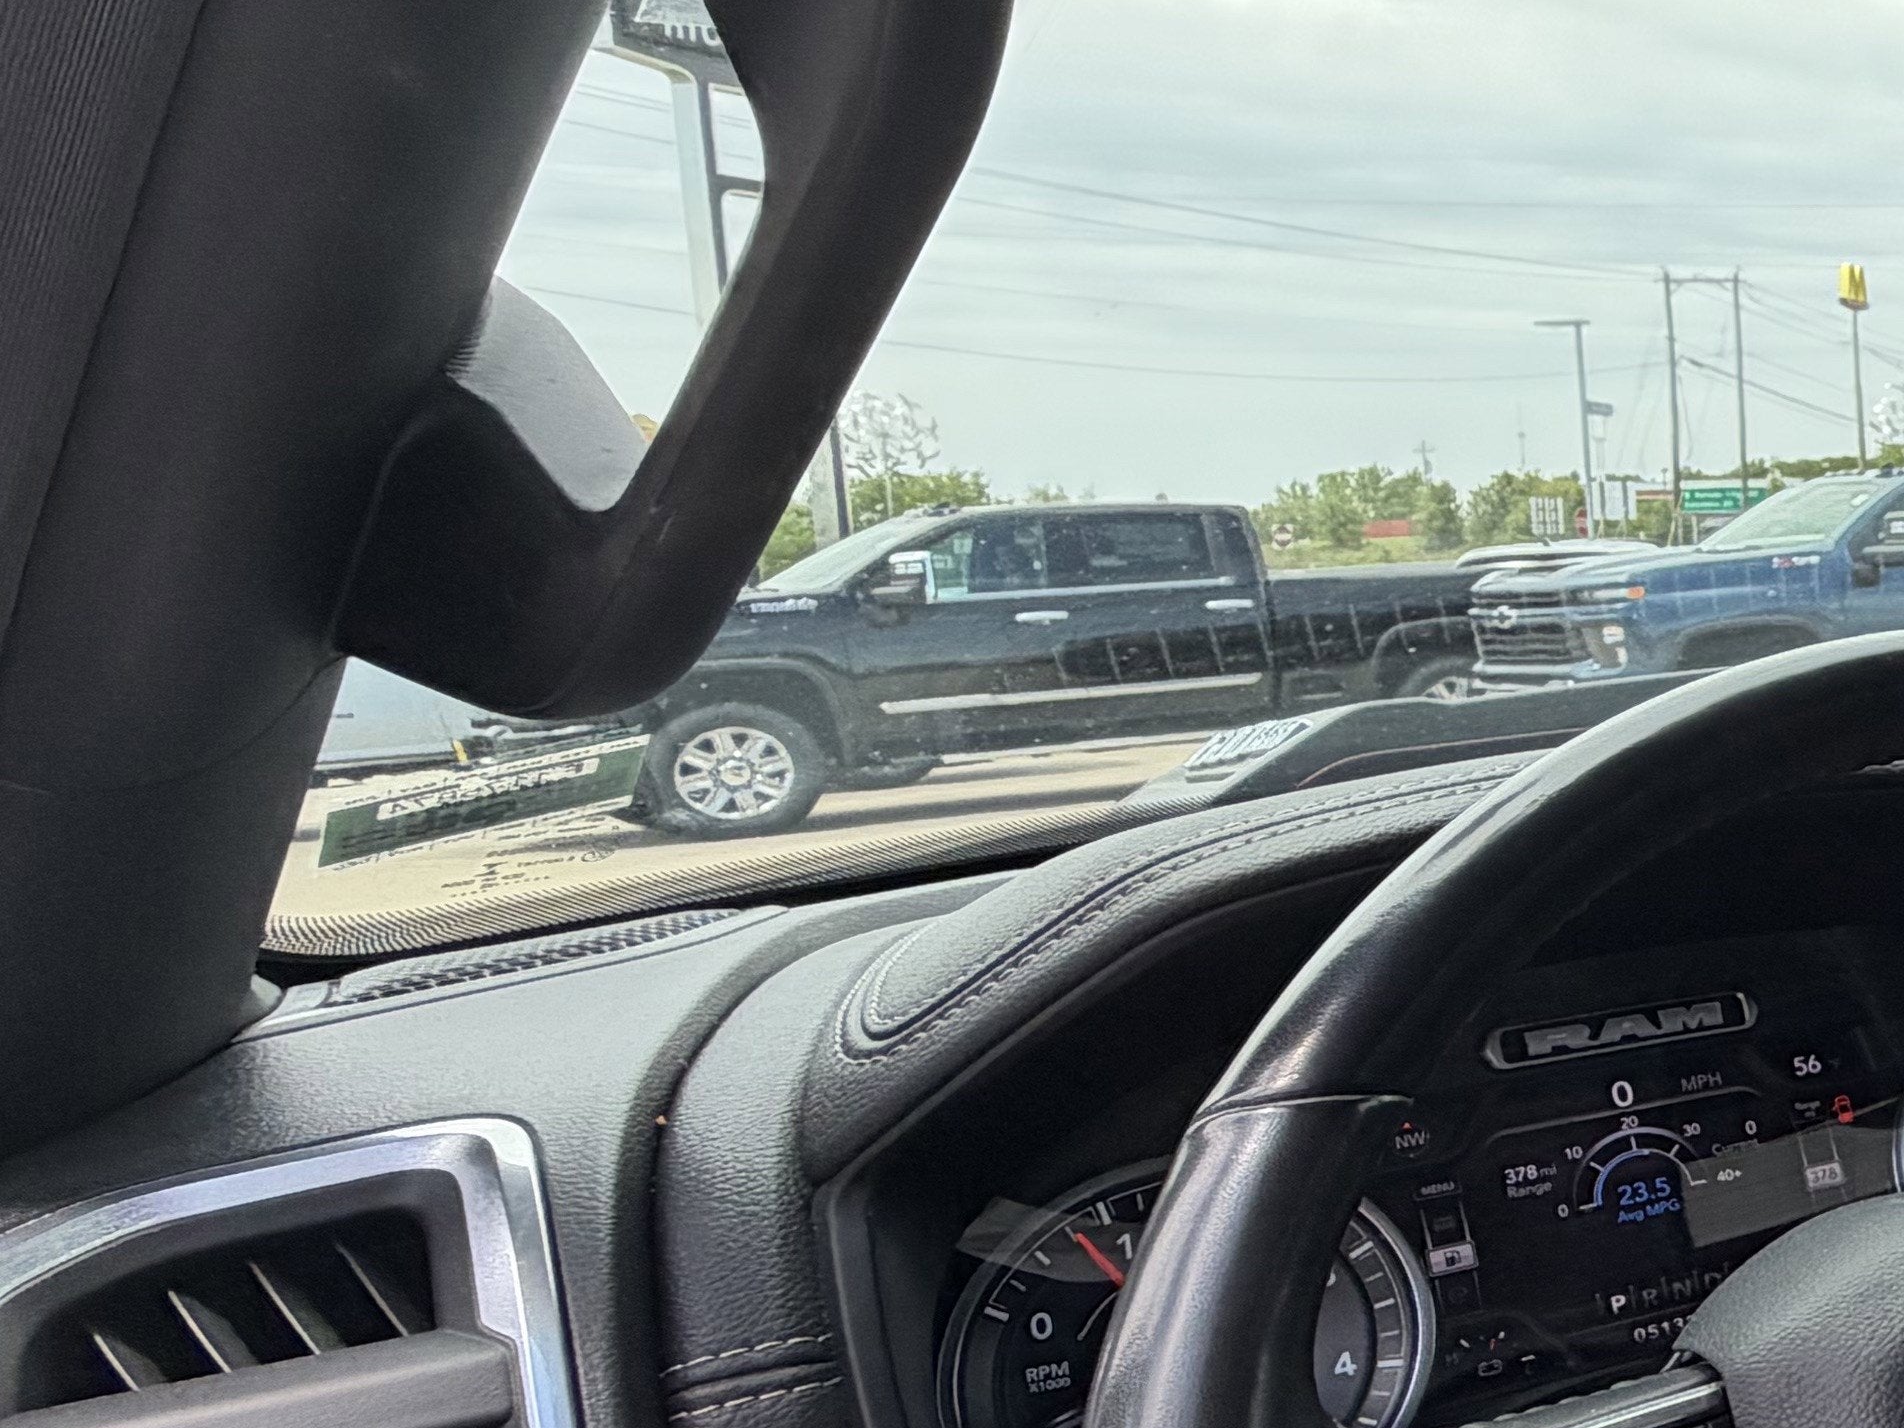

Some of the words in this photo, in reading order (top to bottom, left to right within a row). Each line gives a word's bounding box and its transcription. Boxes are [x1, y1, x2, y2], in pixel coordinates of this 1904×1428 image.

[1523, 1001, 1724, 1057] RAM
[1793, 1054, 1822, 1076] 56
[1611, 1080, 1634, 1107] 0
[1681, 1072, 1723, 1092] MPH
[1620, 1115, 1639, 1130] 20
[1682, 1123, 1701, 1137] 30
[1744, 1120, 1758, 1135] 0
[1395, 1131, 1425, 1150] NW
[1564, 1145, 1584, 1160] 10
[1504, 1164, 1538, 1185] 378
[1506, 1180, 1553, 1199] Range
[1617, 1177, 1671, 1206] 23.5
[1557, 1204, 1570, 1218] 0
[1617, 1208, 1645, 1223] Avg
[1645, 1199, 1681, 1218] MPG
[1115, 1232, 1135, 1261] 1
[1610, 1294, 1627, 1315] P
[1030, 1312, 1053, 1340] 0
[1025, 1360, 1070, 1383] RPM
[1334, 1350, 1358, 1377] 4
